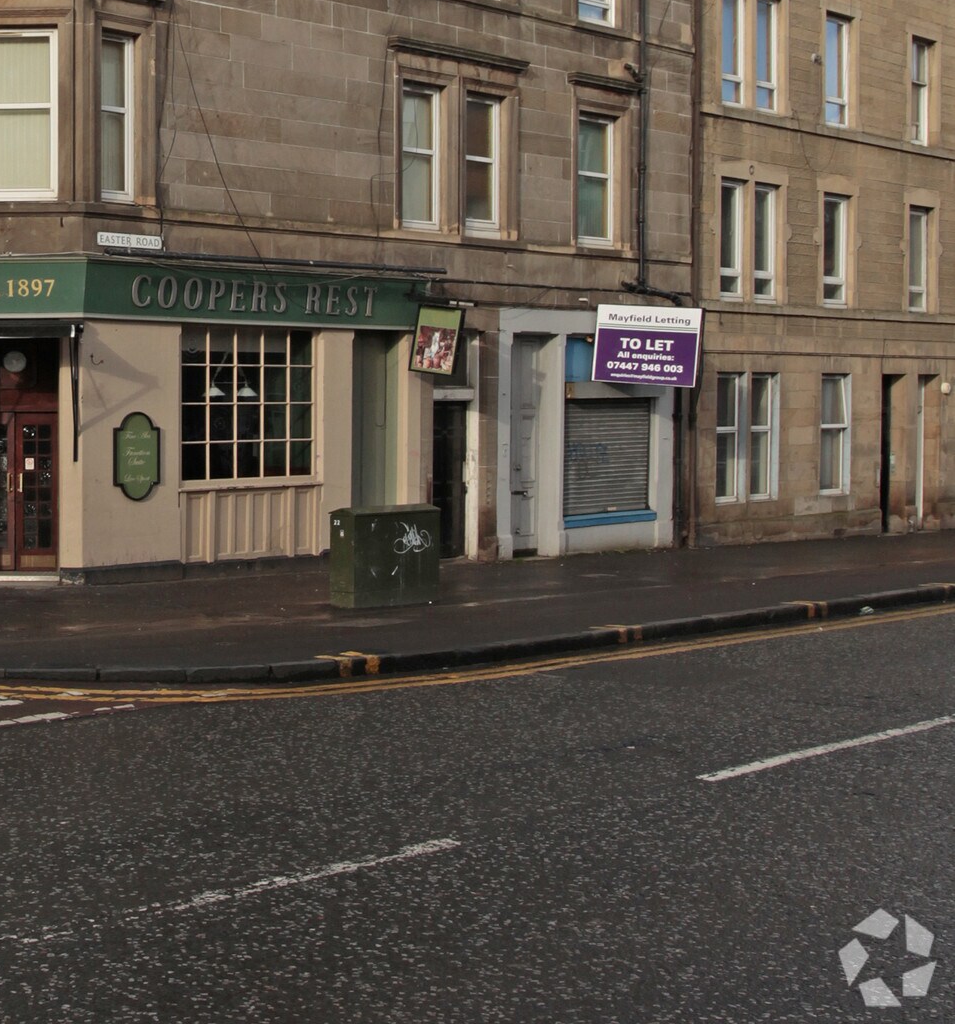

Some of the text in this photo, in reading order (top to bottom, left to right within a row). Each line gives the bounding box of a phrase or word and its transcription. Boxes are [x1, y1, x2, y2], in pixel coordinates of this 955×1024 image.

[99, 234, 161, 248] EASTER ROAD
[6, 278, 56, 298] 1897
[131, 274, 378, 317] COOPERS REST
[608, 313, 691, 326] Mayfield Letting
[620, 337, 675, 351] TO LET
[631, 353, 675, 361] enquiries:
[607, 361, 684, 373] 07447 946 003
